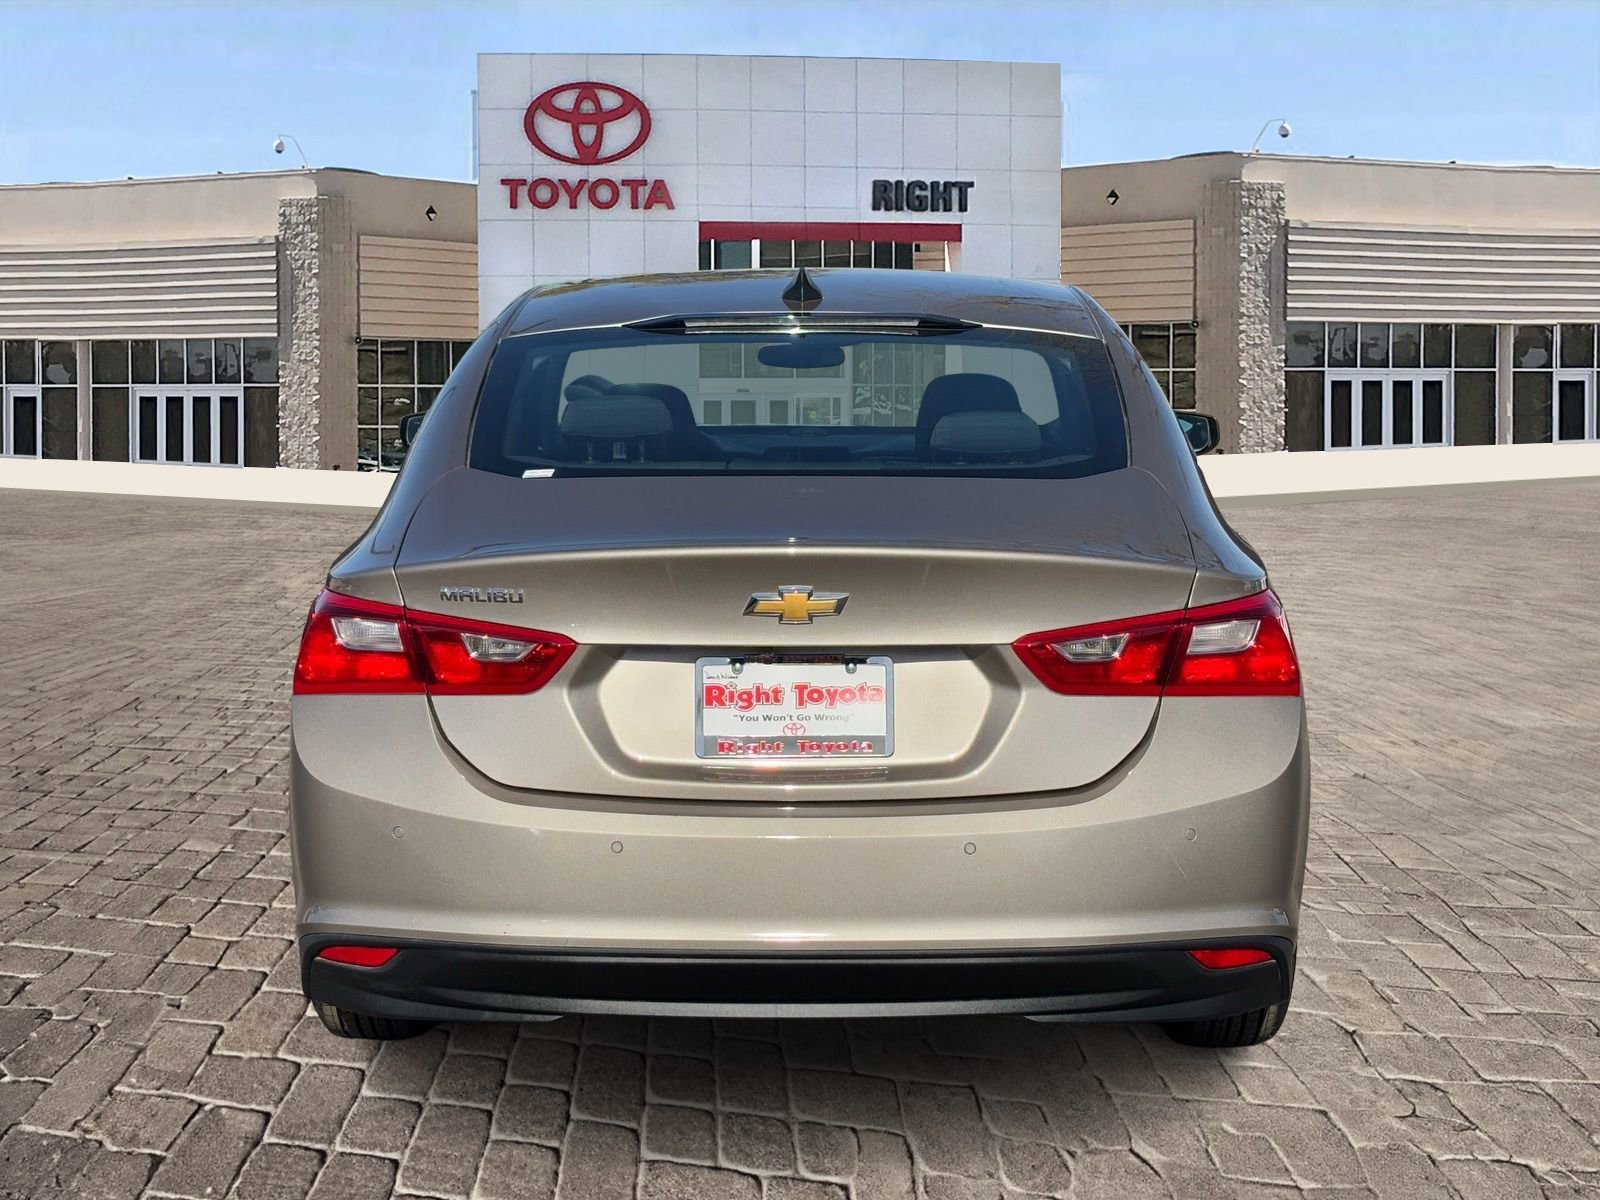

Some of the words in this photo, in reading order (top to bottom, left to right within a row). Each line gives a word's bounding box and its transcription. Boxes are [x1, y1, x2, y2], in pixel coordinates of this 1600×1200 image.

[500, 178, 675, 209] TOYOTA
[871, 179, 975, 212] RIGHT
[439, 586, 524, 603] MALIBU
[703, 682, 785, 711] Right
[791, 682, 886, 709] Toyota
[733, 713, 759, 722] "You
[761, 713, 794, 722] Won't
[796, 713, 811, 722] Go
[718, 740, 784, 755] Right
[798, 741, 873, 754] Toyota
